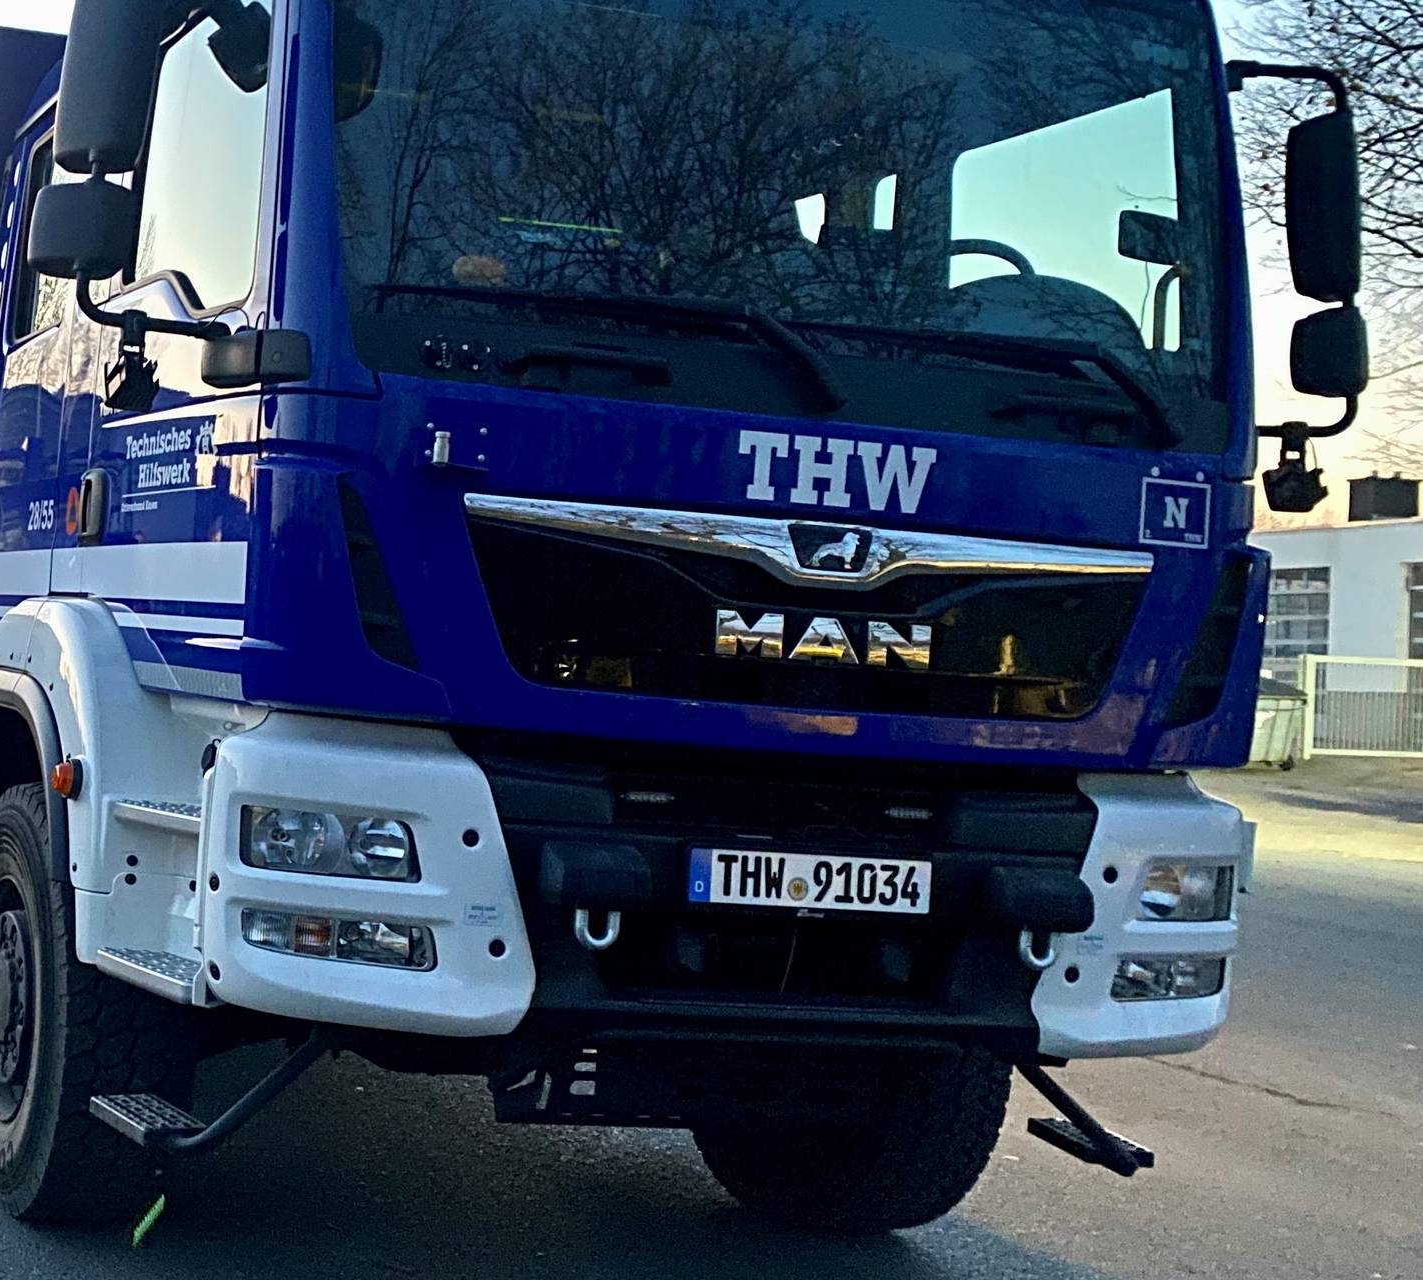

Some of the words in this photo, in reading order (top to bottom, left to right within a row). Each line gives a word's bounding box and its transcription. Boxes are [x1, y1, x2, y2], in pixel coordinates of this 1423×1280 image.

[125, 426, 192, 460] Technisches
[137, 457, 191, 488] Hilfswerk
[738, 429, 938, 514] THW
[27, 499, 55, 531] 28/55
[1162, 495, 1190, 529] N
[715, 609, 933, 669] MAN
[694, 880, 704, 893] D
[717, 854, 786, 899] THW
[813, 861, 921, 907] 91034
